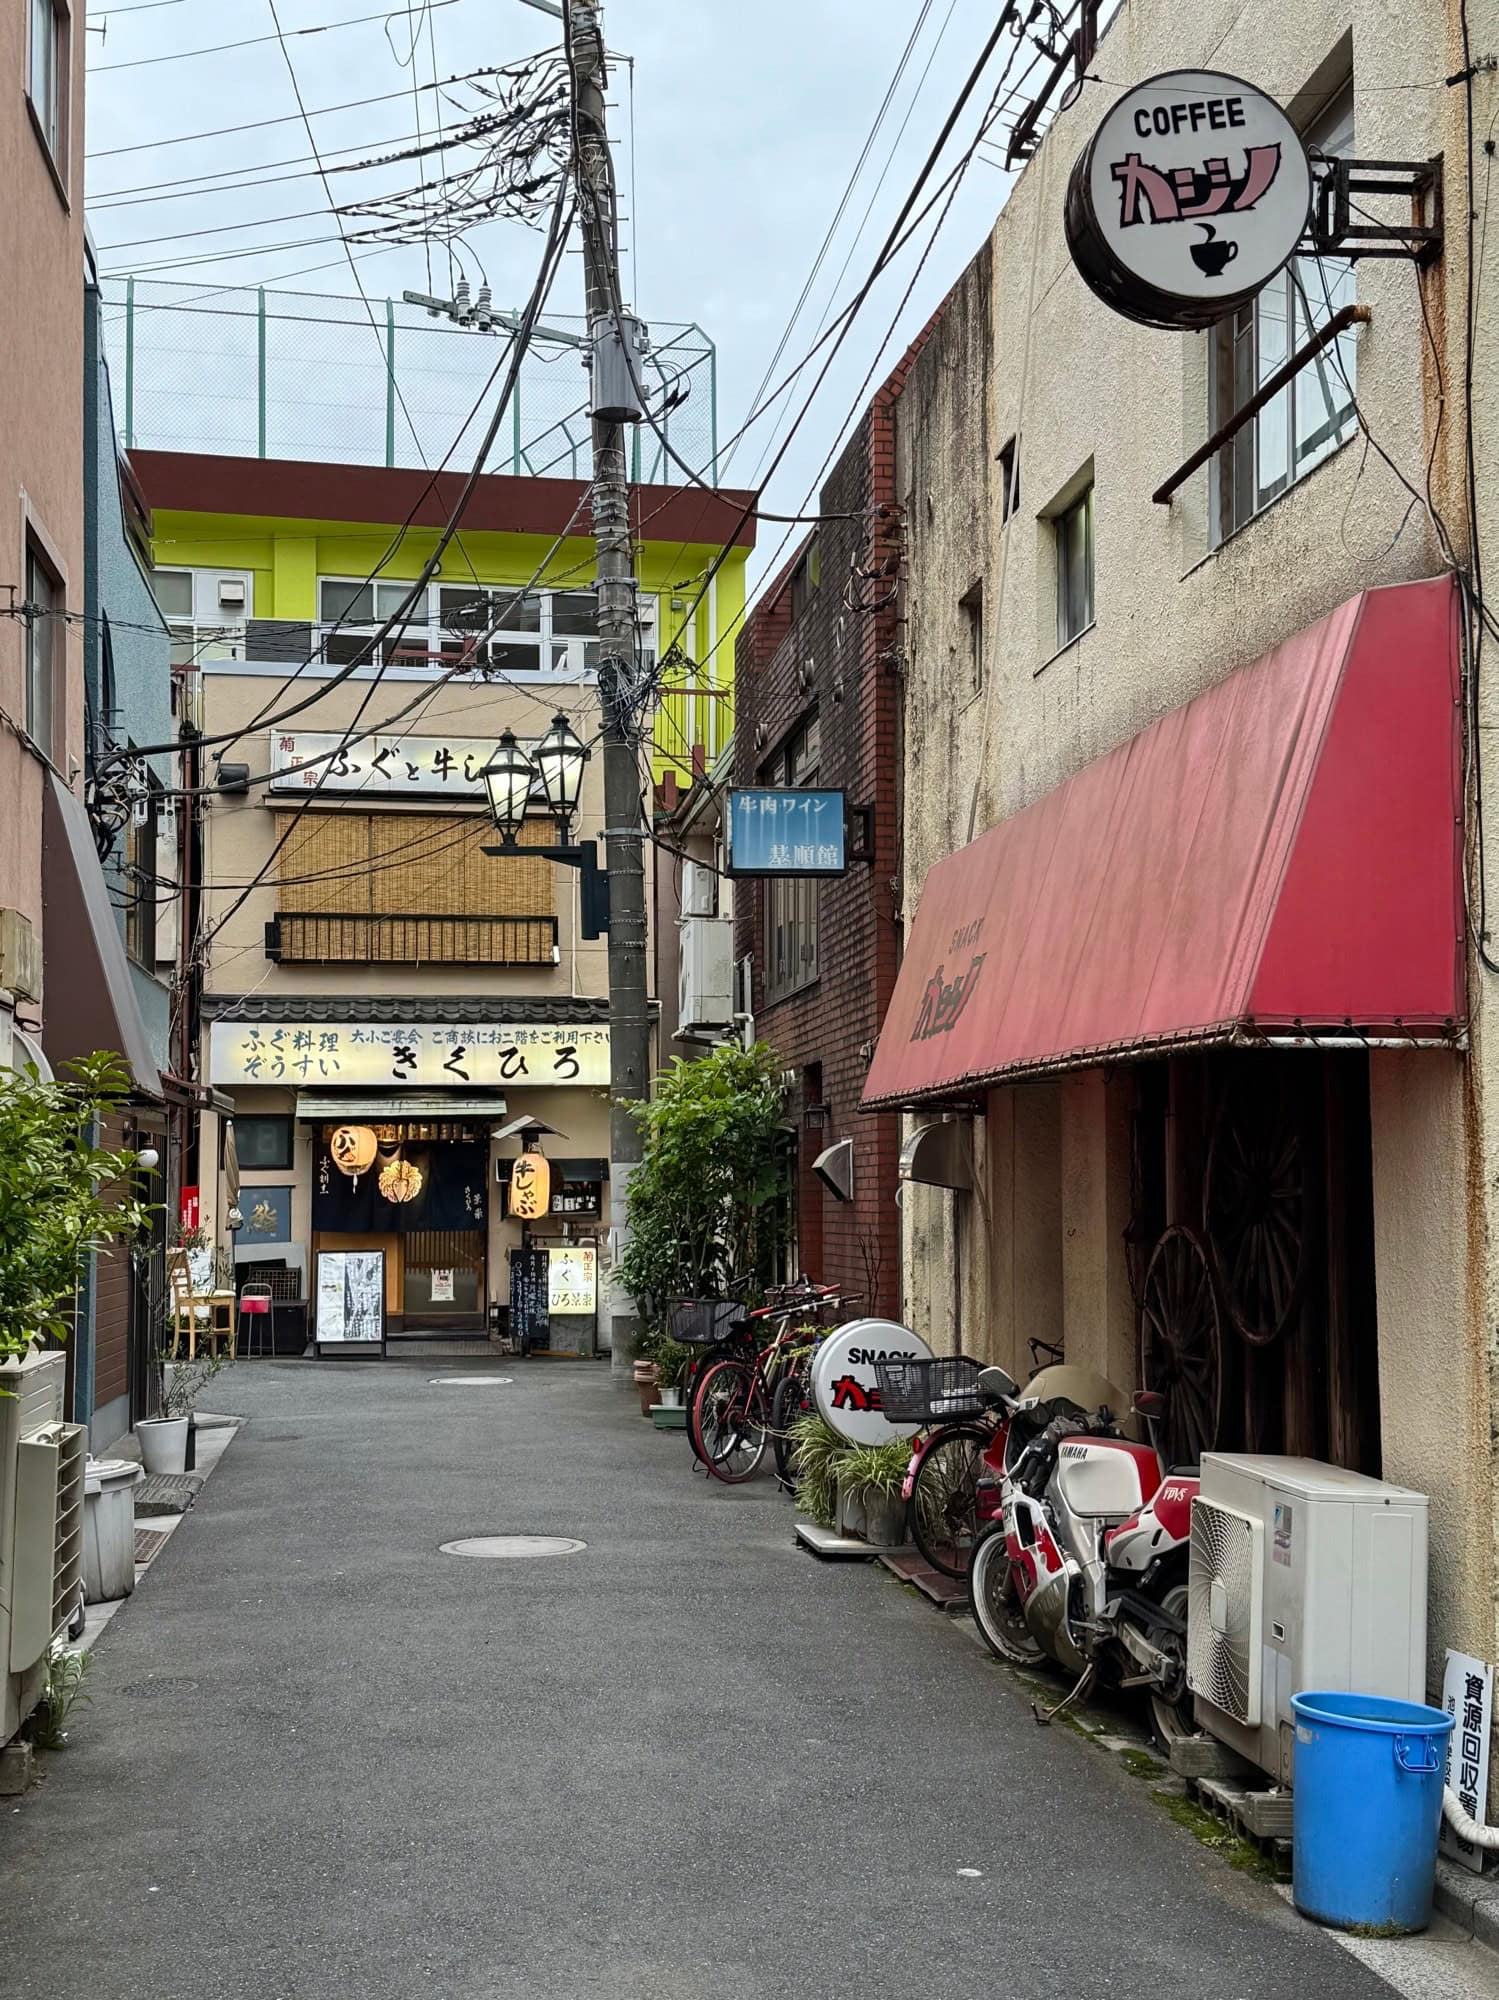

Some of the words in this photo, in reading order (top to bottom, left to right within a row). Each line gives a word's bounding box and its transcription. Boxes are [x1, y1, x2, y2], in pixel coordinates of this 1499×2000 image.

[1134, 97, 1246, 138] COFFEE
[1110, 142, 1281, 228] カジノ
[242, 1029, 339, 1053] ふぐ料理
[243, 1054, 341, 1079] ぞうすい
[392, 1046, 580, 1081] きくひろ
[515, 1160, 537, 1214] 牛しゃぶ
[560, 1253, 574, 1282] ふぐ
[1061, 1445, 1088, 1461] YAMAHA
